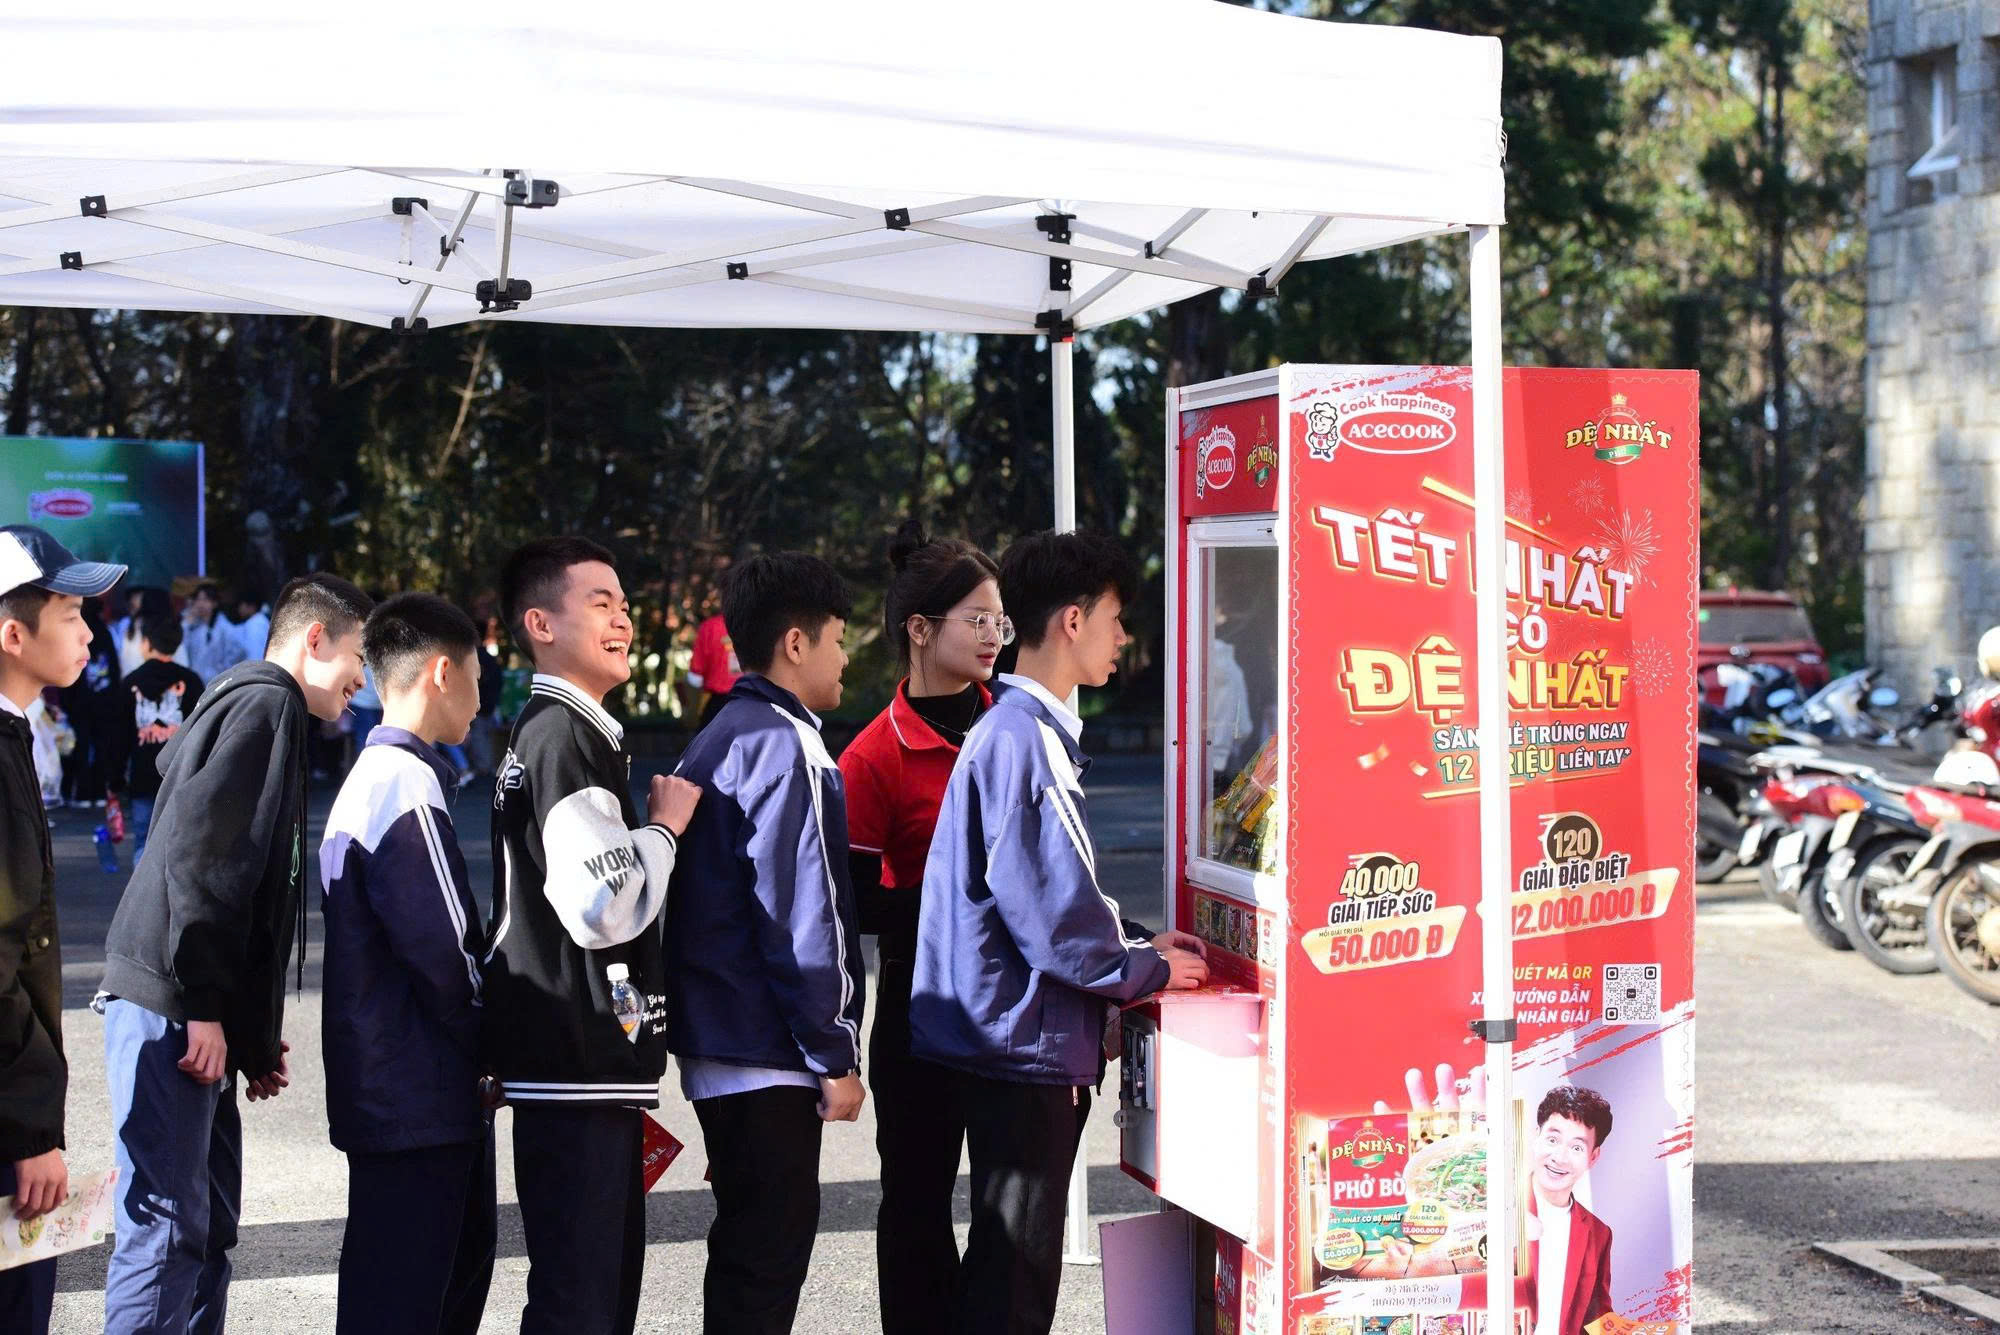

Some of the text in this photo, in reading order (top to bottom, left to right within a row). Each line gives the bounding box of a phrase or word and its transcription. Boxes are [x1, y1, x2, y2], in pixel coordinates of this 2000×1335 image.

[1340, 394, 1453, 417] Cook happiness
[1566, 420, 1672, 449] ĐỆ NHẤT
[1314, 505, 1457, 586] TẾT
[1340, 635, 1466, 724] ĐỆ
[1528, 721, 1585, 744] TRÚNG
[1589, 722, 1629, 740] NGAY
[1440, 754, 1475, 781] 12
[1559, 747, 1594, 770] LIỀN
[1553, 828, 1592, 858] 120
[1340, 862, 1420, 897] 40.000
[1523, 854, 1628, 891] GIẢI ĐẶC BIỆT
[1331, 891, 1433, 924] GIẢI TIẾP SỨC
[1640, 883, 1656, 915] Đ
[1329, 924, 1444, 967] 50.000 Đ
[1514, 964, 1592, 980] UÉT MÃ QR
[1514, 983, 1590, 1004] ƯỚNG DẪN
[1516, 1007, 1590, 1027] NHẬN GIẢI
[1359, 1136, 1406, 1155] NHẤT
[1334, 1171, 1407, 1199] PHỞ BÒ
